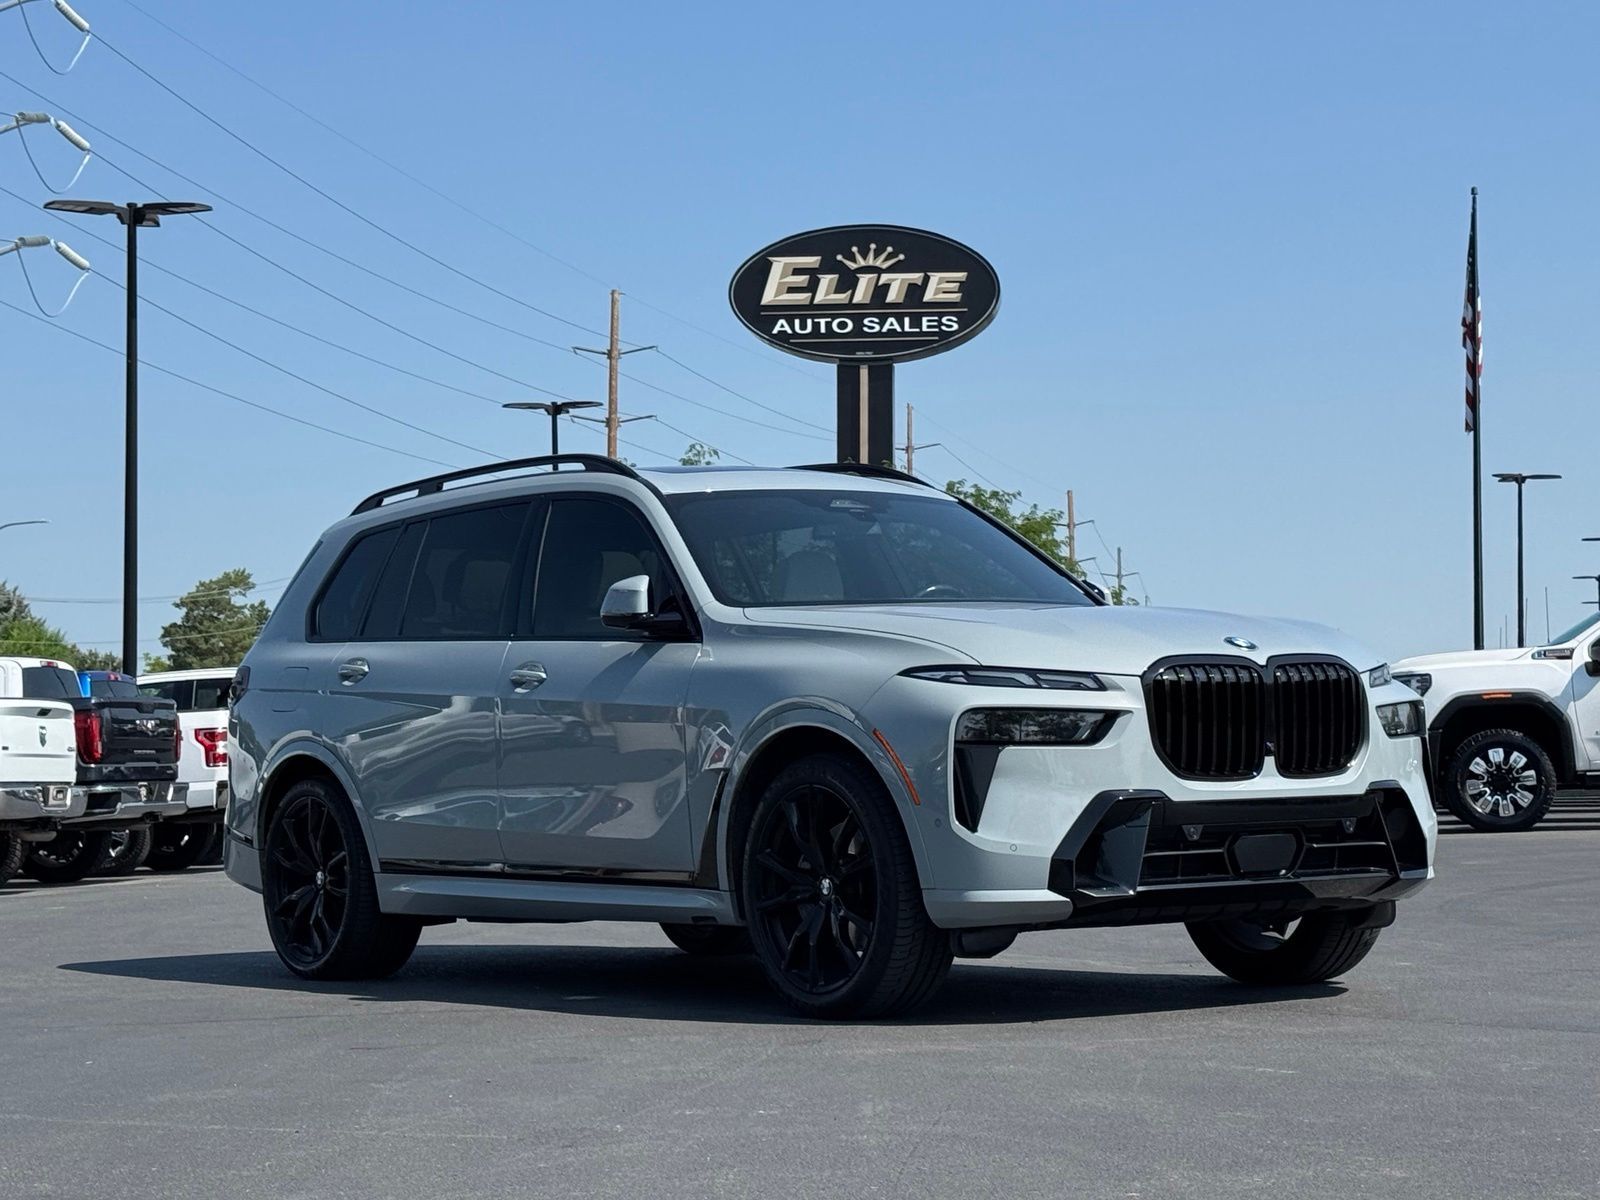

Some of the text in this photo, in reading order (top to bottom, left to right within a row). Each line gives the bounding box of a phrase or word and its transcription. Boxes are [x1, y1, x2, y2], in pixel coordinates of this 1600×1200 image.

[760, 256, 968, 305] ELITE
[772, 316, 959, 334] AUTO SALES
